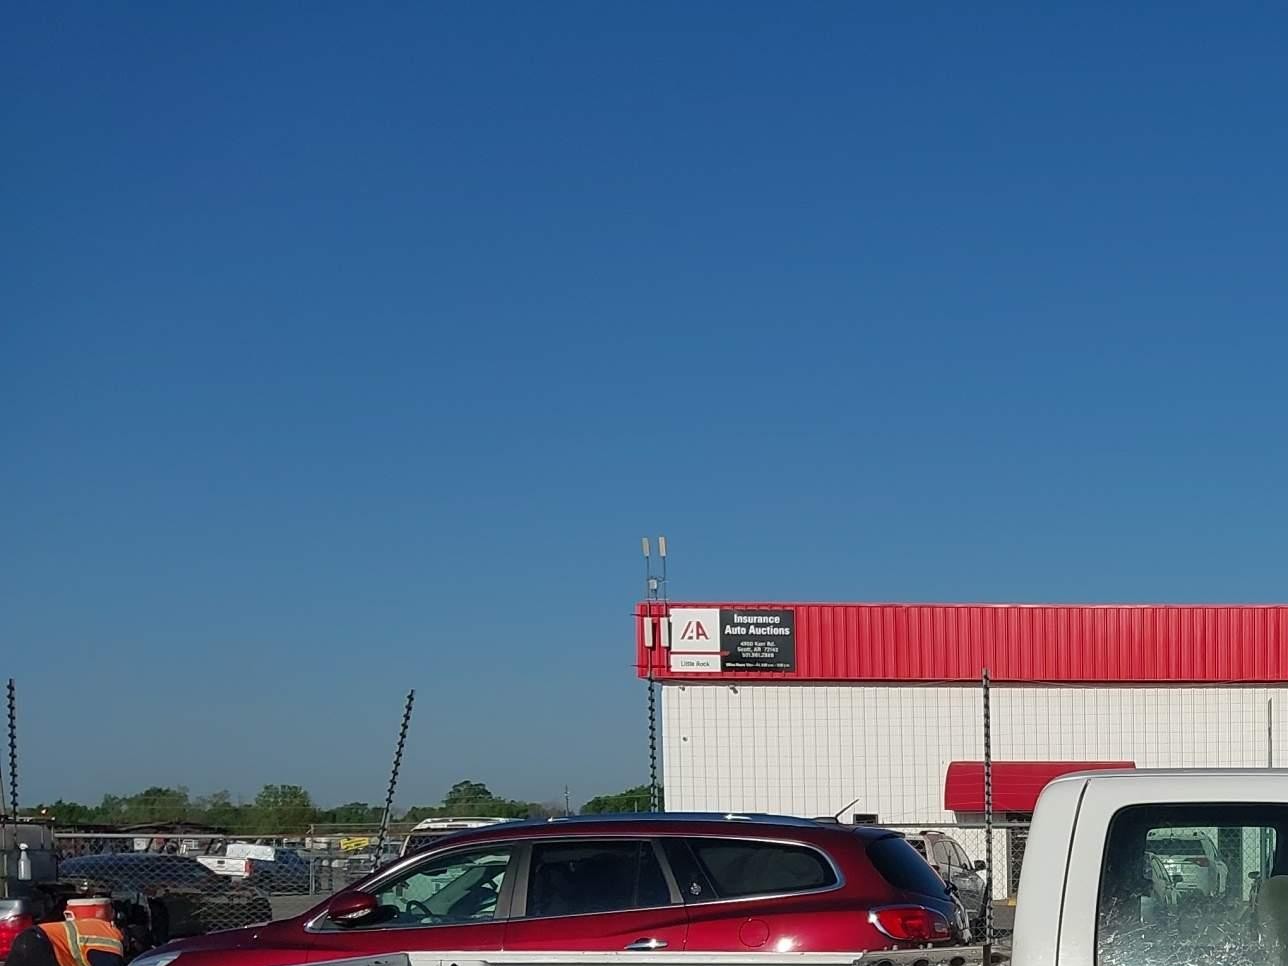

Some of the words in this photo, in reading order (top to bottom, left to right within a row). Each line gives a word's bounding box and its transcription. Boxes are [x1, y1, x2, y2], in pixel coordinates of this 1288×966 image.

[734, 613, 780, 624] Insurance
[724, 624, 747, 635] Auto
[748, 624, 790, 635] Auctions
